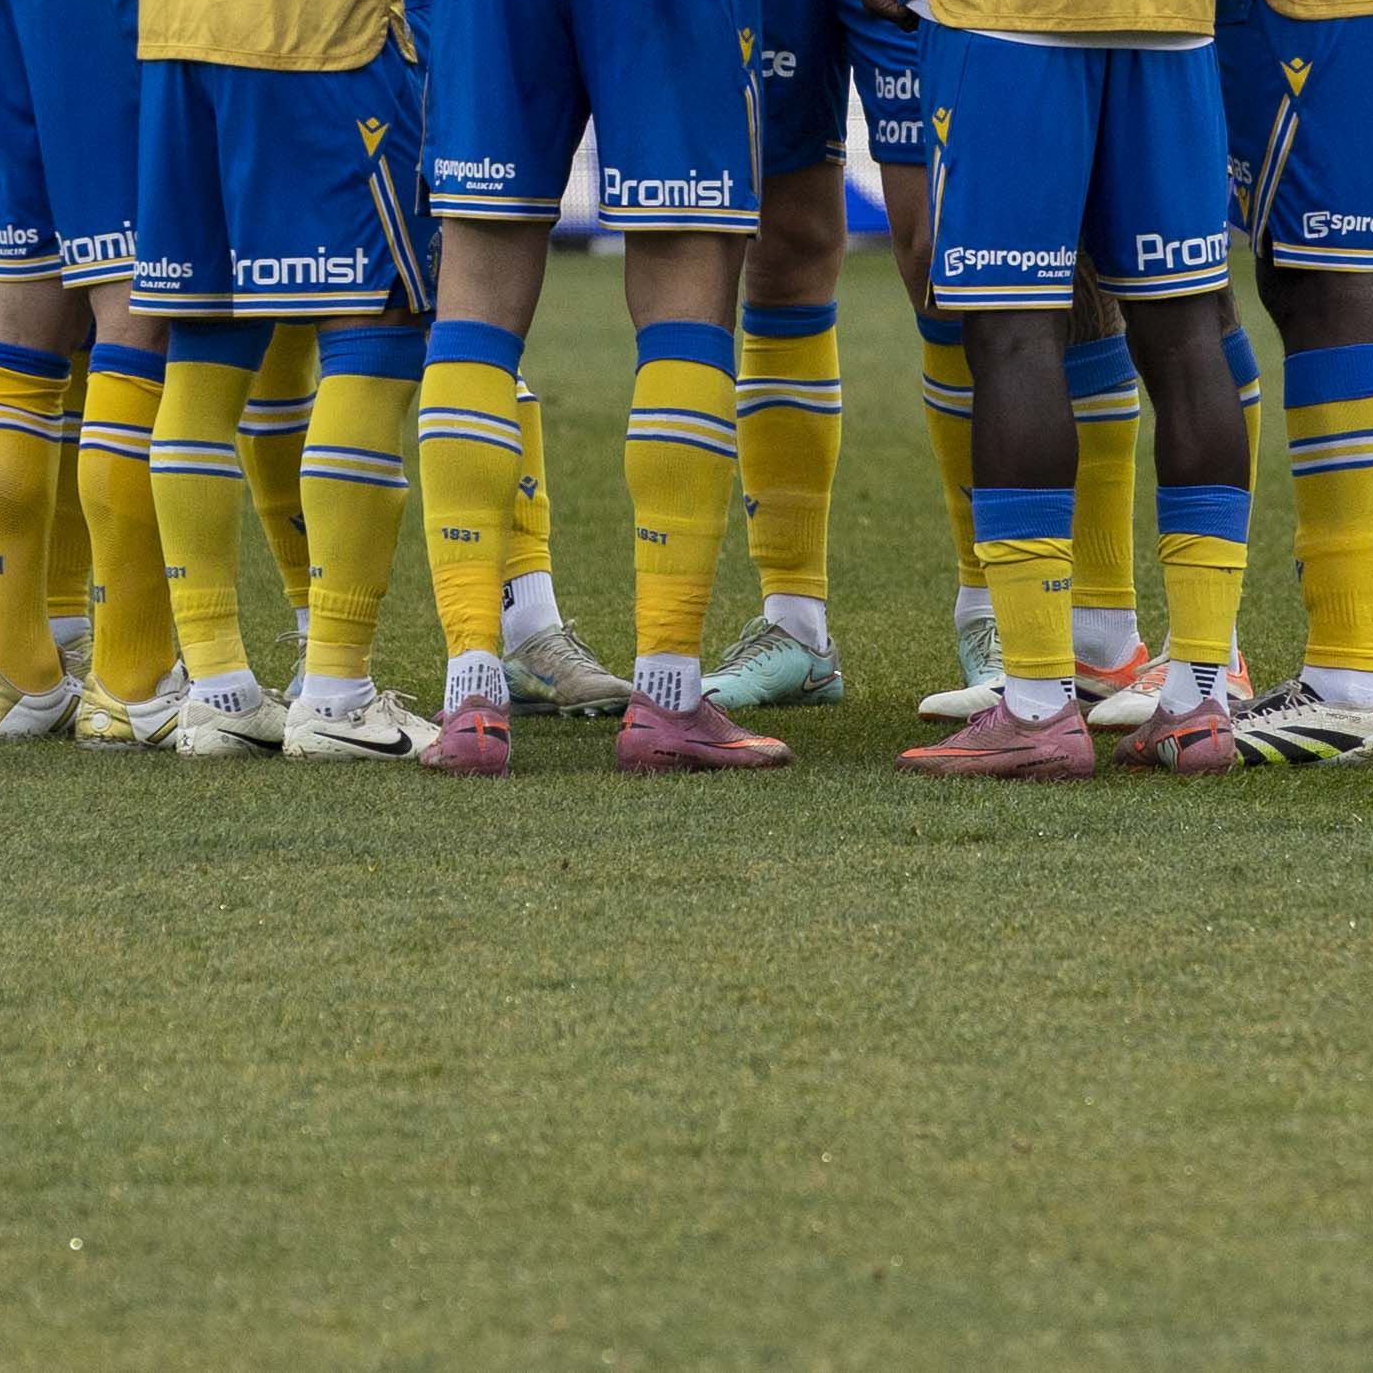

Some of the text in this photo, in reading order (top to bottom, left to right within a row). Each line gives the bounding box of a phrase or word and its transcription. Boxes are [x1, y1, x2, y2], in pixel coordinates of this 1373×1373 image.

[876, 67, 921, 100] bad
[603, 169, 734, 208] Promist
[55, 220, 138, 265] romi
[230, 246, 369, 287] romist
[441, 527, 480, 543] 1931
